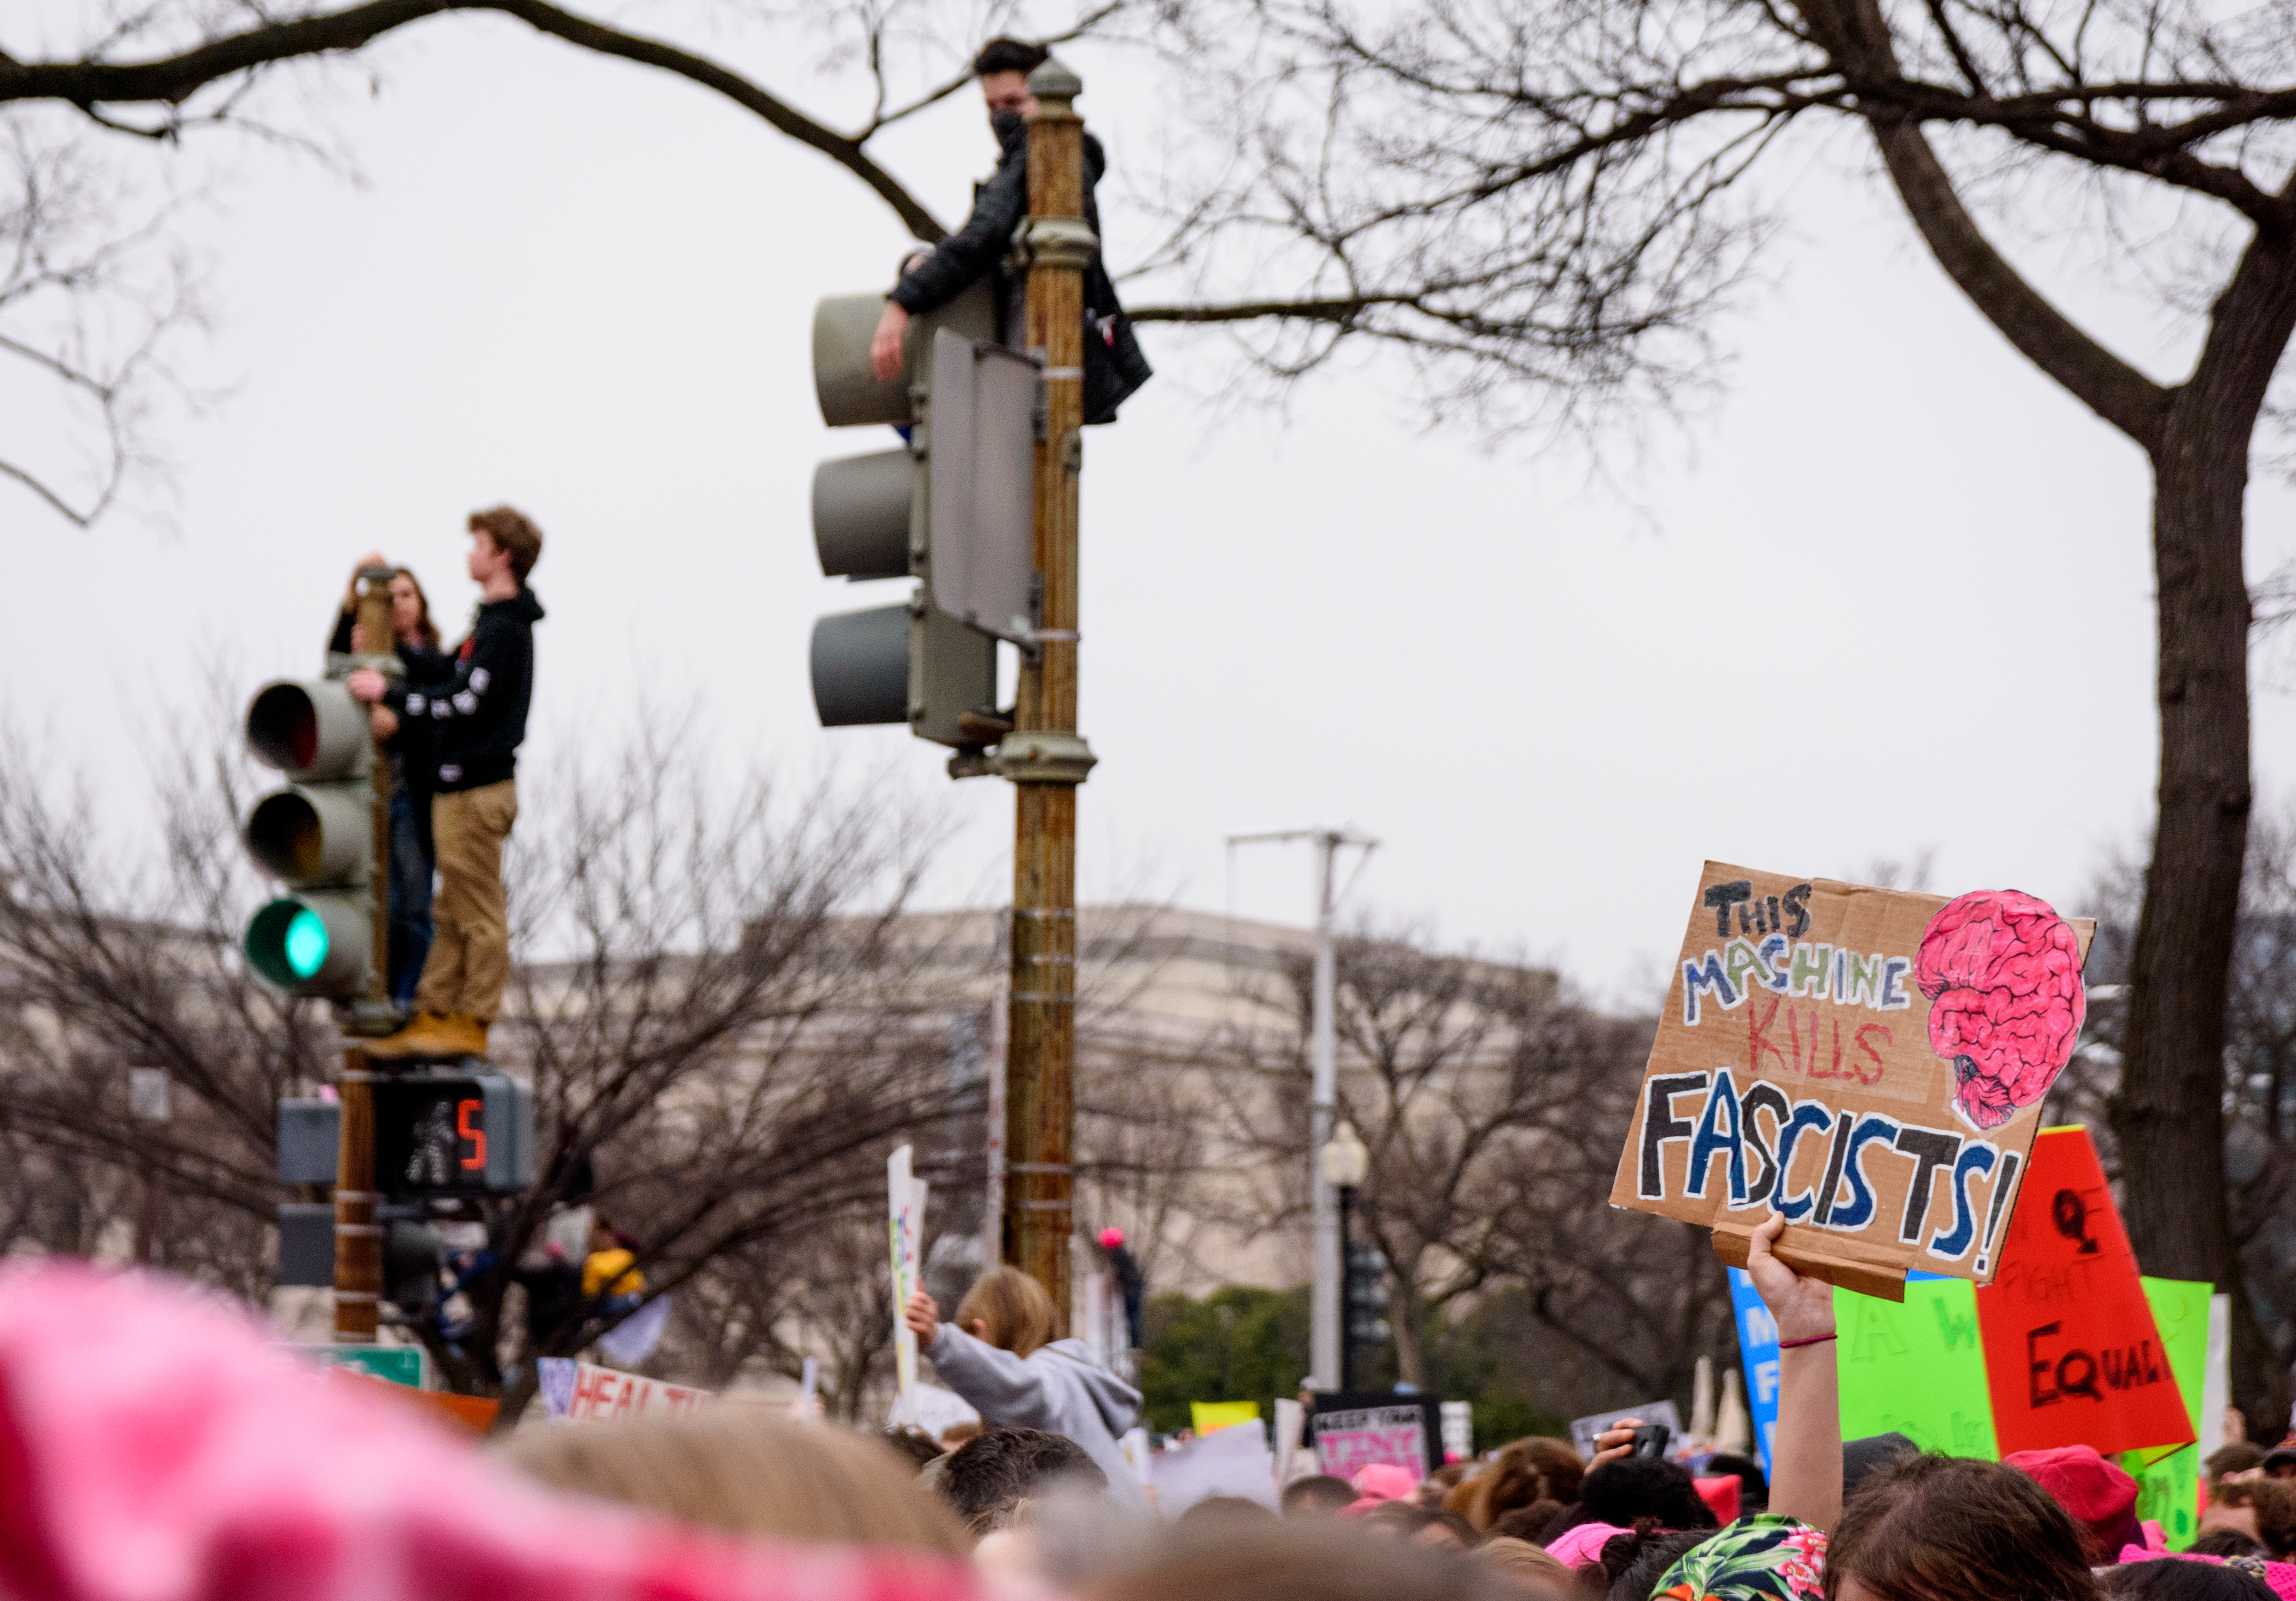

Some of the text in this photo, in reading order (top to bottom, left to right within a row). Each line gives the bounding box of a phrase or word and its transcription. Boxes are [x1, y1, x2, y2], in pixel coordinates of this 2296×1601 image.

[1704, 880, 1811, 937] THIS
[1683, 933, 1911, 1025] MACHINE
[1748, 996, 1892, 1085] KILLS
[458, 1099, 488, 1170] 5
[1638, 1067, 2023, 1275] FASCISTS!
